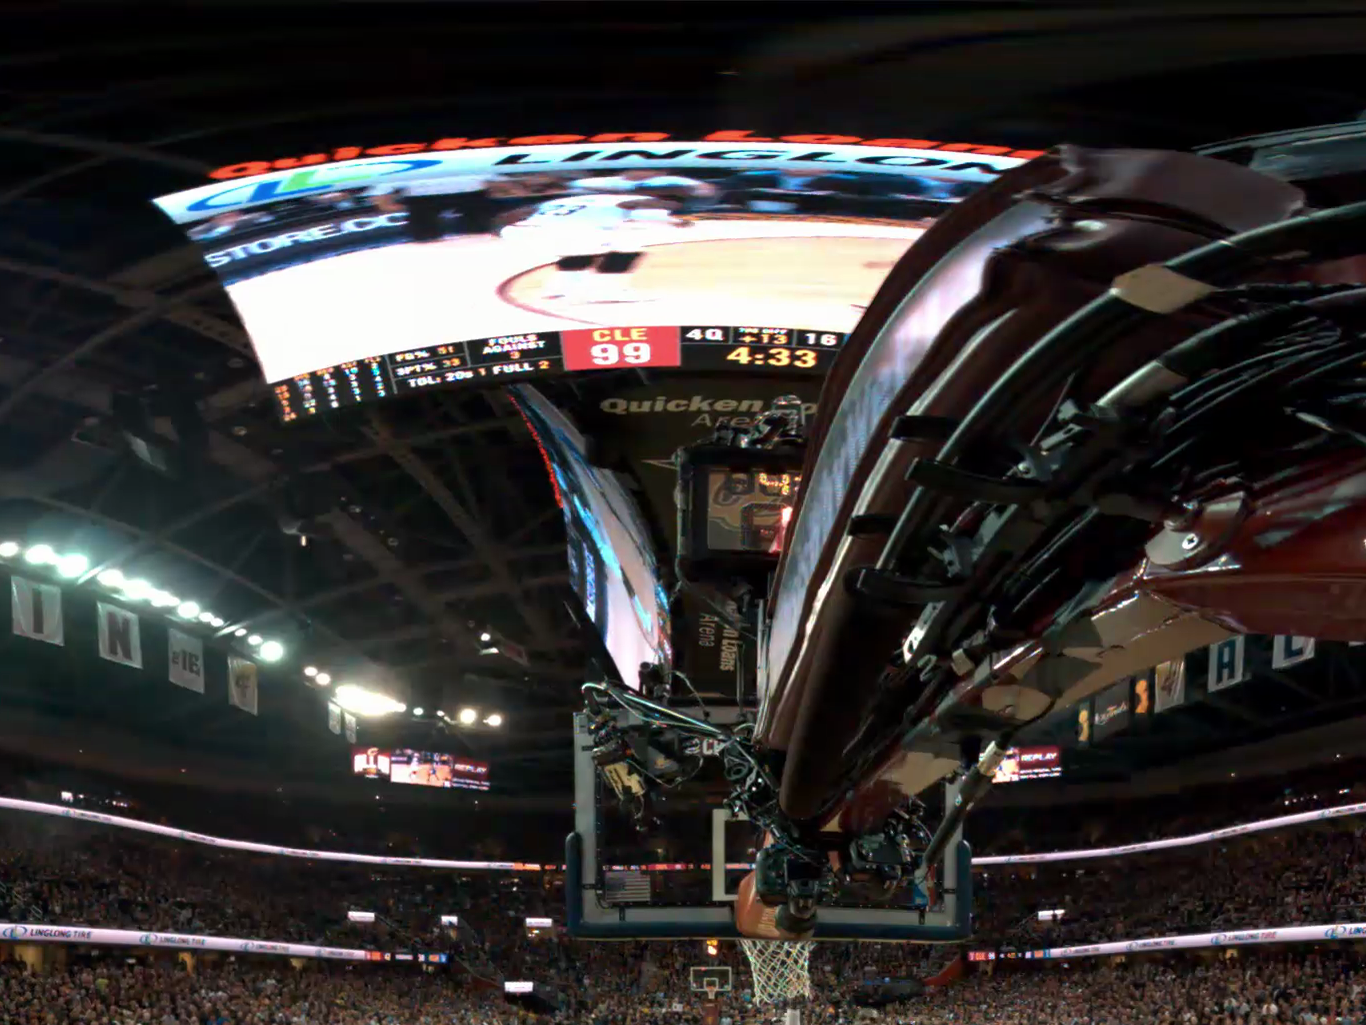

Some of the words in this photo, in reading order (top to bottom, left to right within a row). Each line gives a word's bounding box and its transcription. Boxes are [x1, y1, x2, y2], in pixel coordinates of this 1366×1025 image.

[208, 132, 671, 179] Quicken
[592, 328, 648, 342] CLE
[685, 328, 723, 341] 4Q
[805, 333, 837, 345] 16
[483, 340, 546, 354] AGAINST
[590, 343, 651, 365] 99
[727, 347, 817, 367] 4:33
[492, 362, 534, 375] FULL
[539, 360, 550, 370] 2
[600, 396, 764, 415] Quicken
[29, 927, 71, 938] LINGLONG
[72, 930, 92, 939] TIRE
